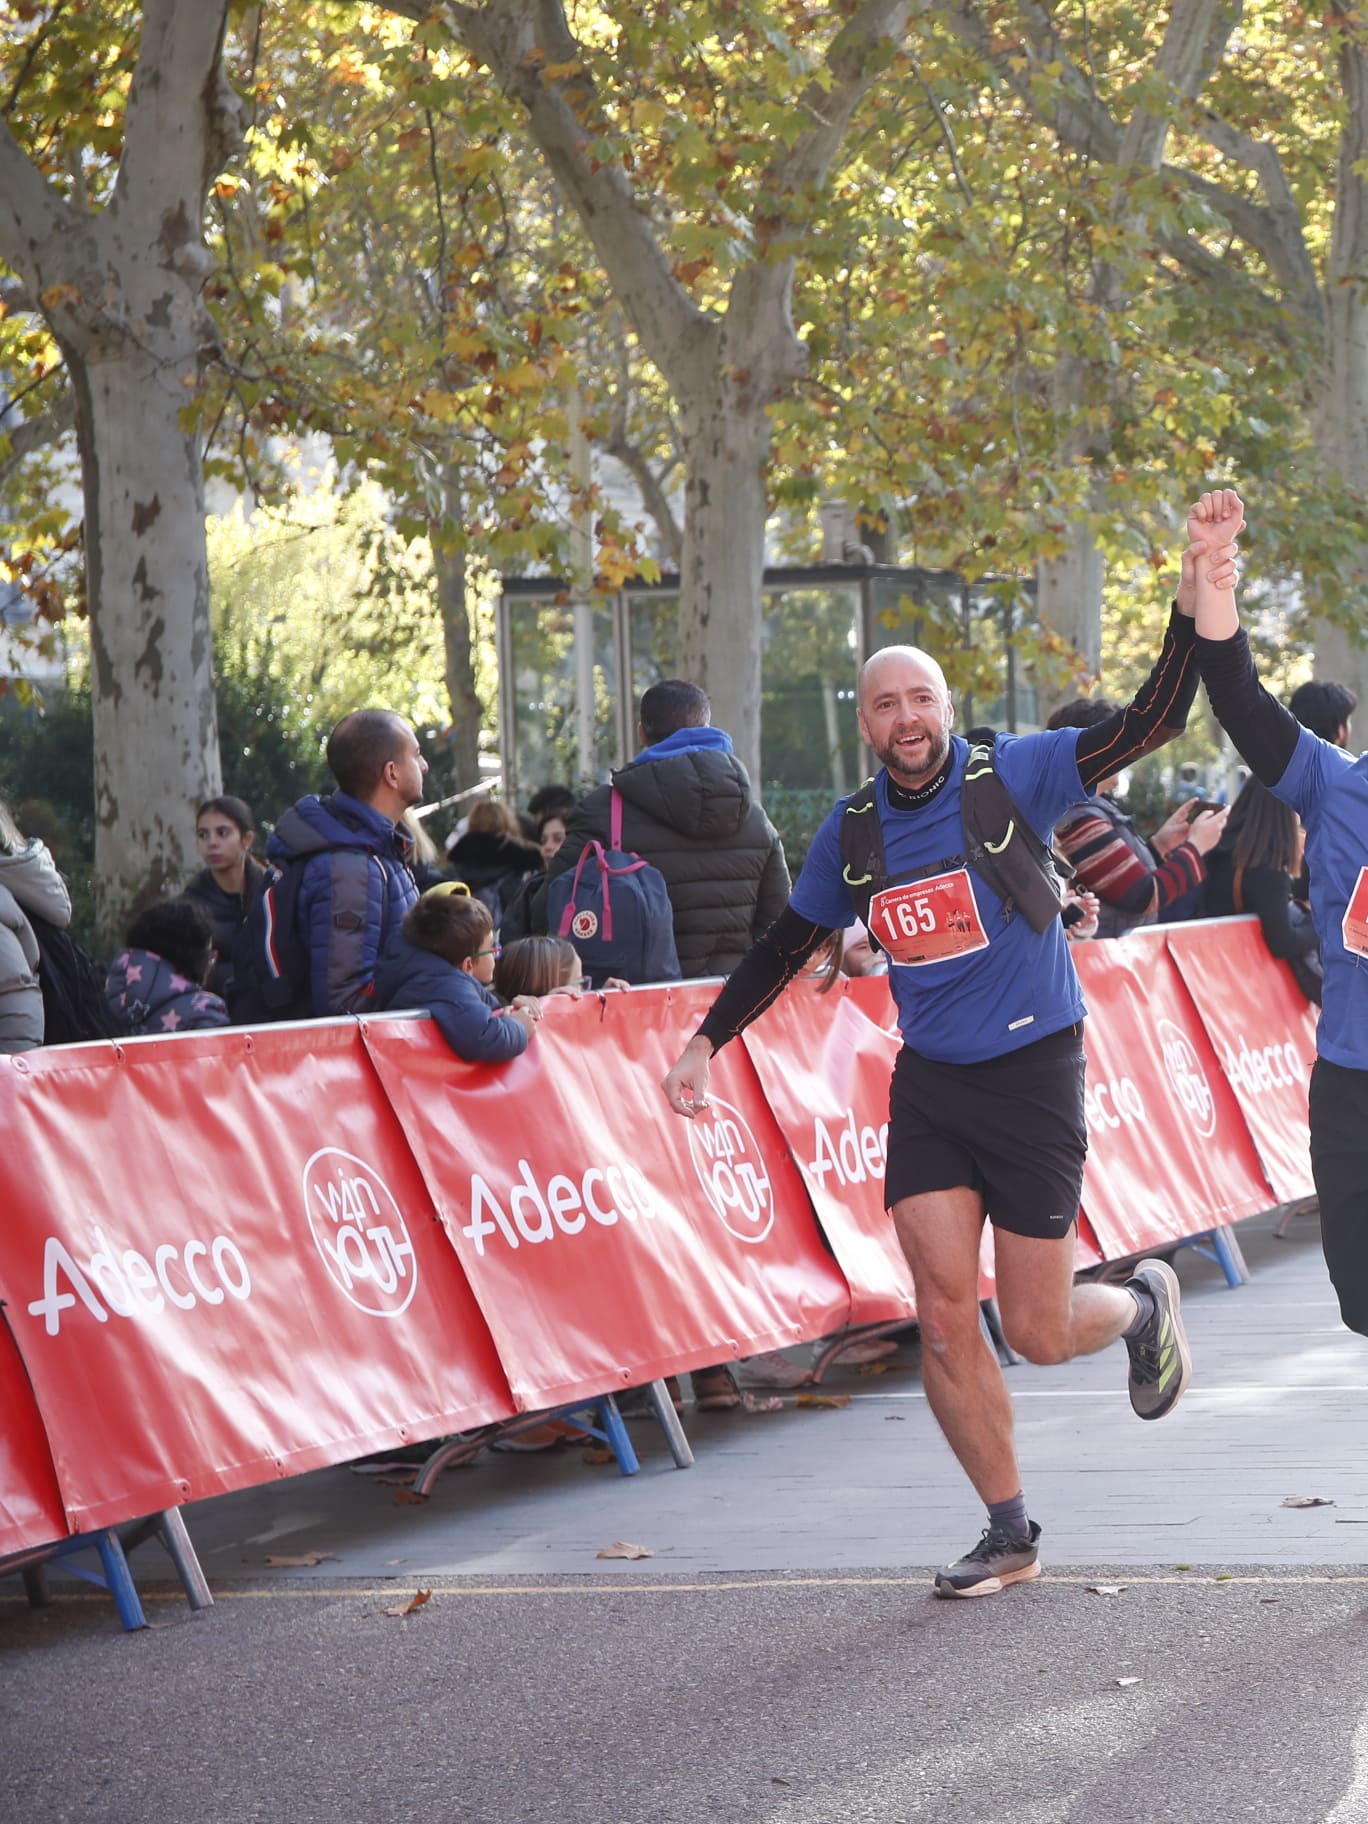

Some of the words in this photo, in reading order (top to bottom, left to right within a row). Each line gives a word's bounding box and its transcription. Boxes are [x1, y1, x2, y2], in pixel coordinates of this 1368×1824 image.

[881, 897, 936, 940] 165
[1223, 1034, 1307, 1095] Adecco
[462, 1158, 657, 1257] Adecco
[28, 1224, 252, 1337] Adecco
